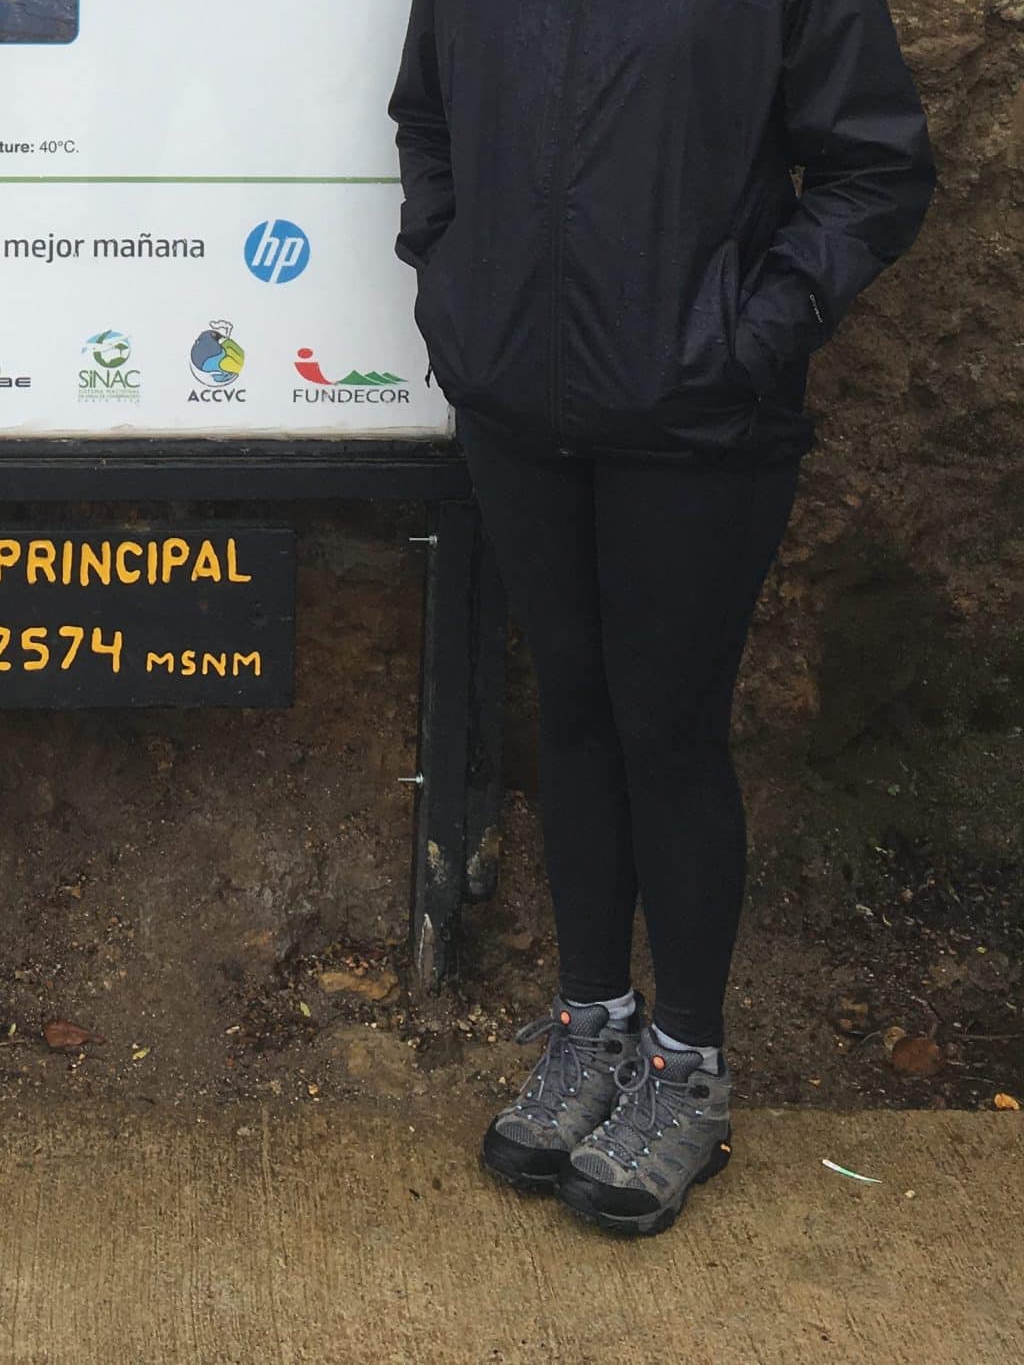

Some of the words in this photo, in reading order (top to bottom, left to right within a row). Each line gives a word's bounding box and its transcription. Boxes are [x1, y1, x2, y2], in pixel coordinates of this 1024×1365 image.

[3, 232, 86, 265] mejor
[93, 232, 205, 259] mañana
[187, 388, 247, 403] ACCVC
[292, 388, 411, 404] FUNDECOR
[146, 649, 262, 676] MSNM
